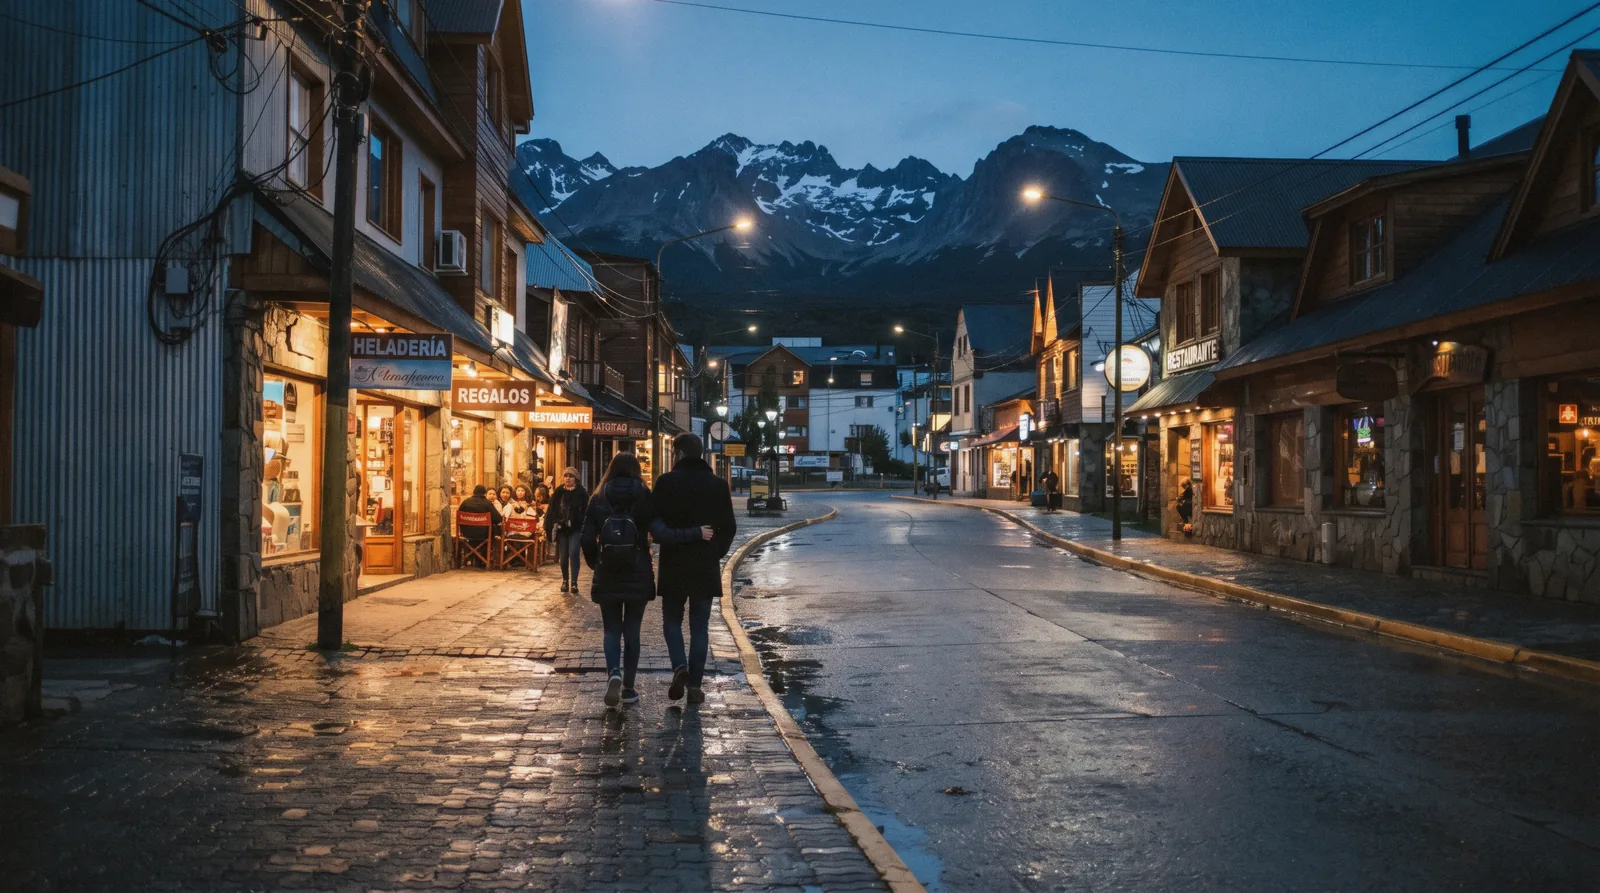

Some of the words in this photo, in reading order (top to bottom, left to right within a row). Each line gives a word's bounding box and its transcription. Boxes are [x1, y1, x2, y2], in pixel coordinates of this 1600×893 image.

[353, 336, 447, 357] HELADERÍA
[1167, 338, 1217, 370] RESTAURANTE
[458, 387, 530, 405] REGALOS
[528, 411, 590, 424] RESTAURANTE
